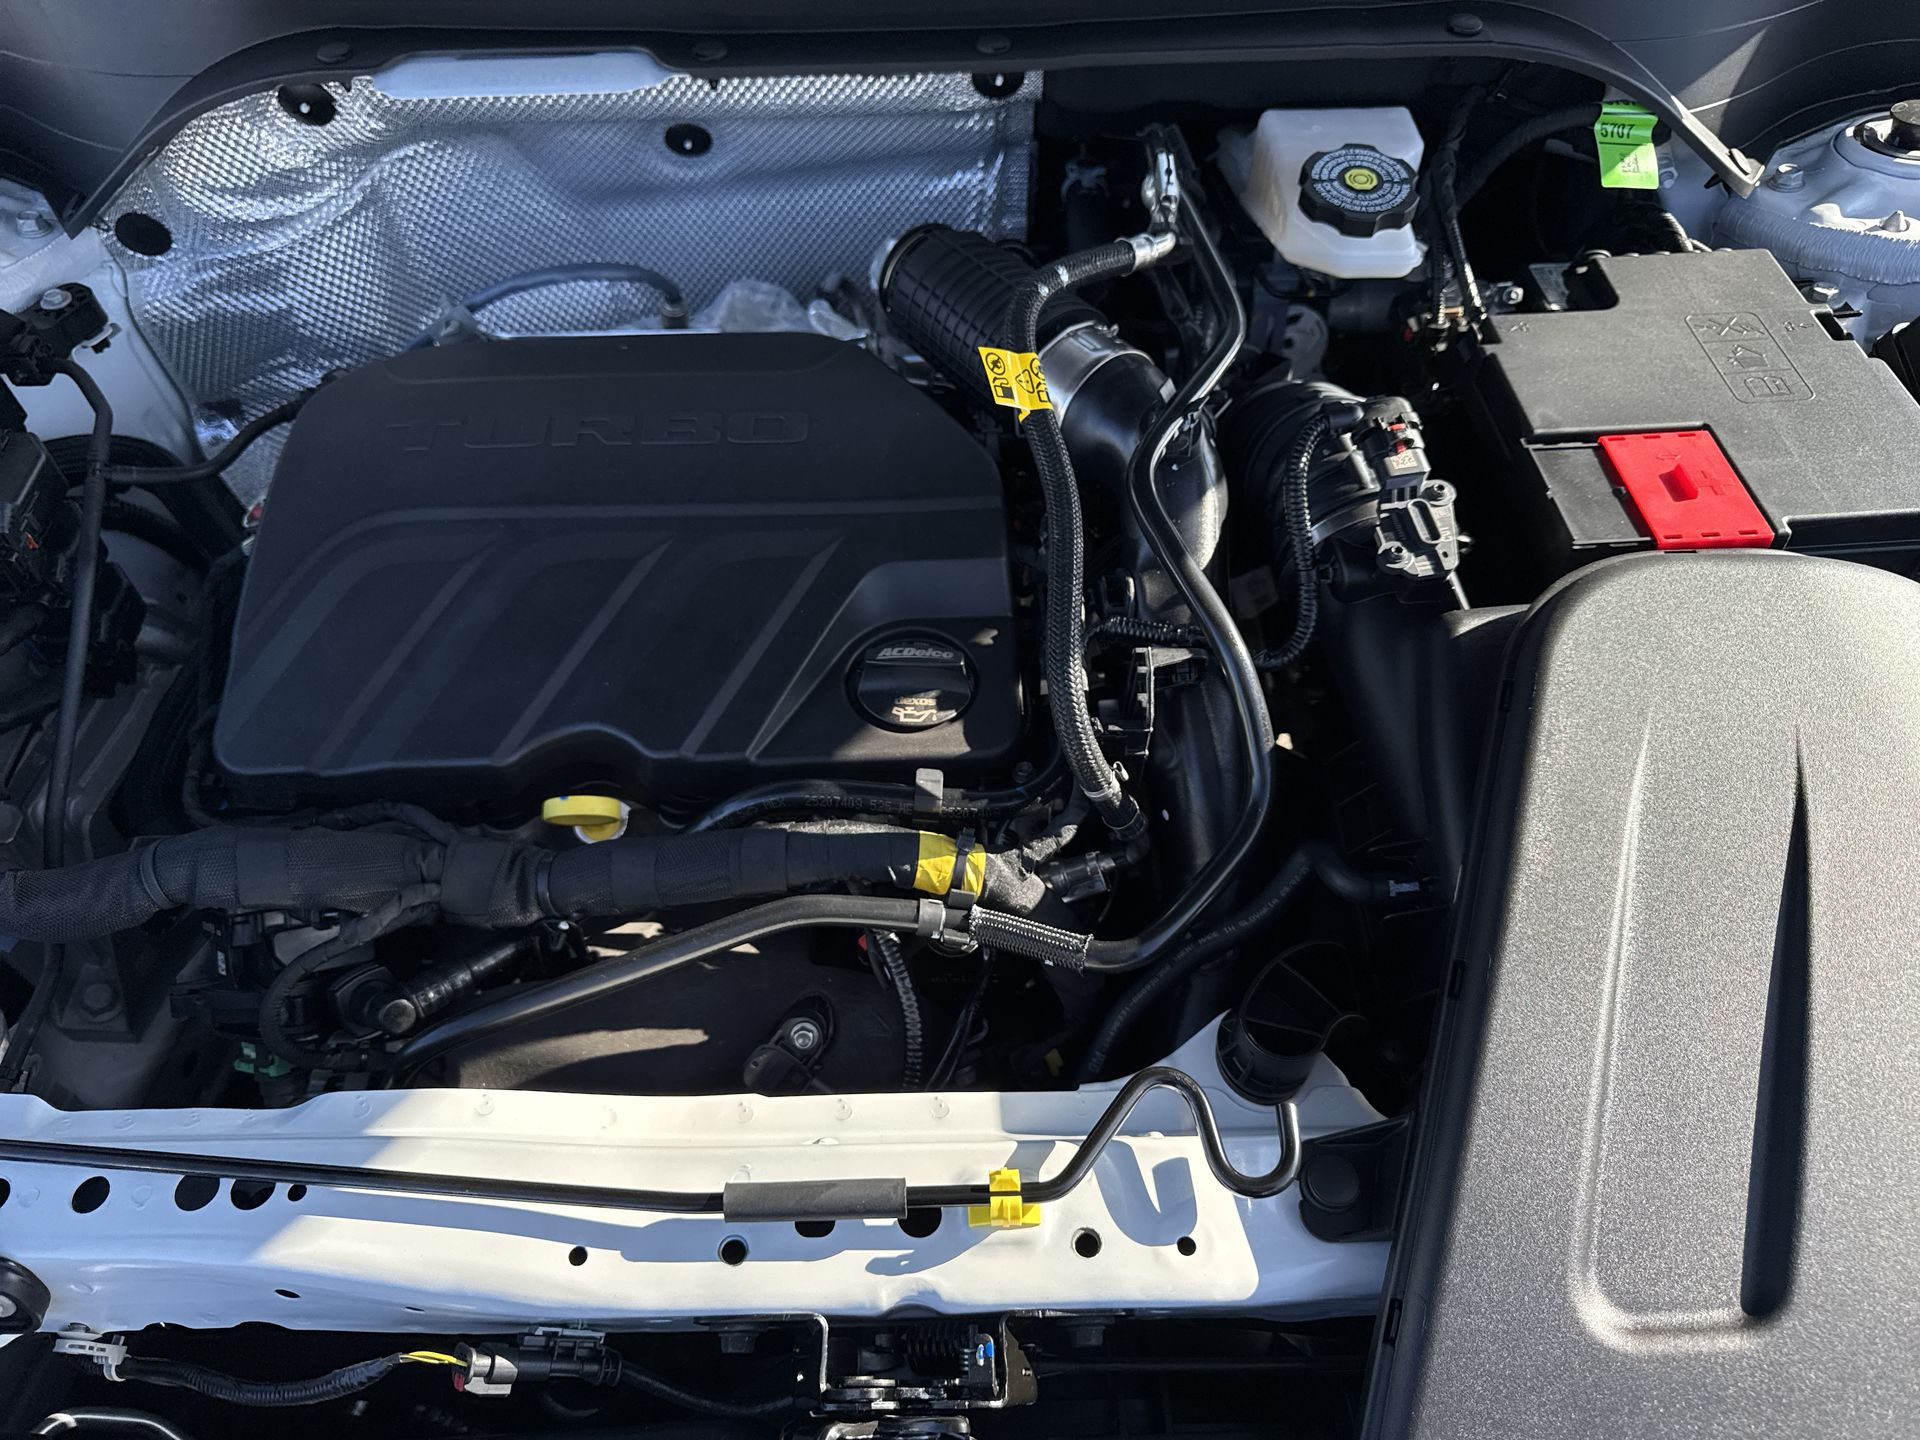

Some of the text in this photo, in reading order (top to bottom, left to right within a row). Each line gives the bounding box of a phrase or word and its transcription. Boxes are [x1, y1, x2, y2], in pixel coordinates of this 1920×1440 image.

[1600, 122, 1636, 139] 5707
[385, 410, 811, 452] TURBO
[876, 647, 954, 659] ACDelco
[894, 696, 937, 706] dexos
